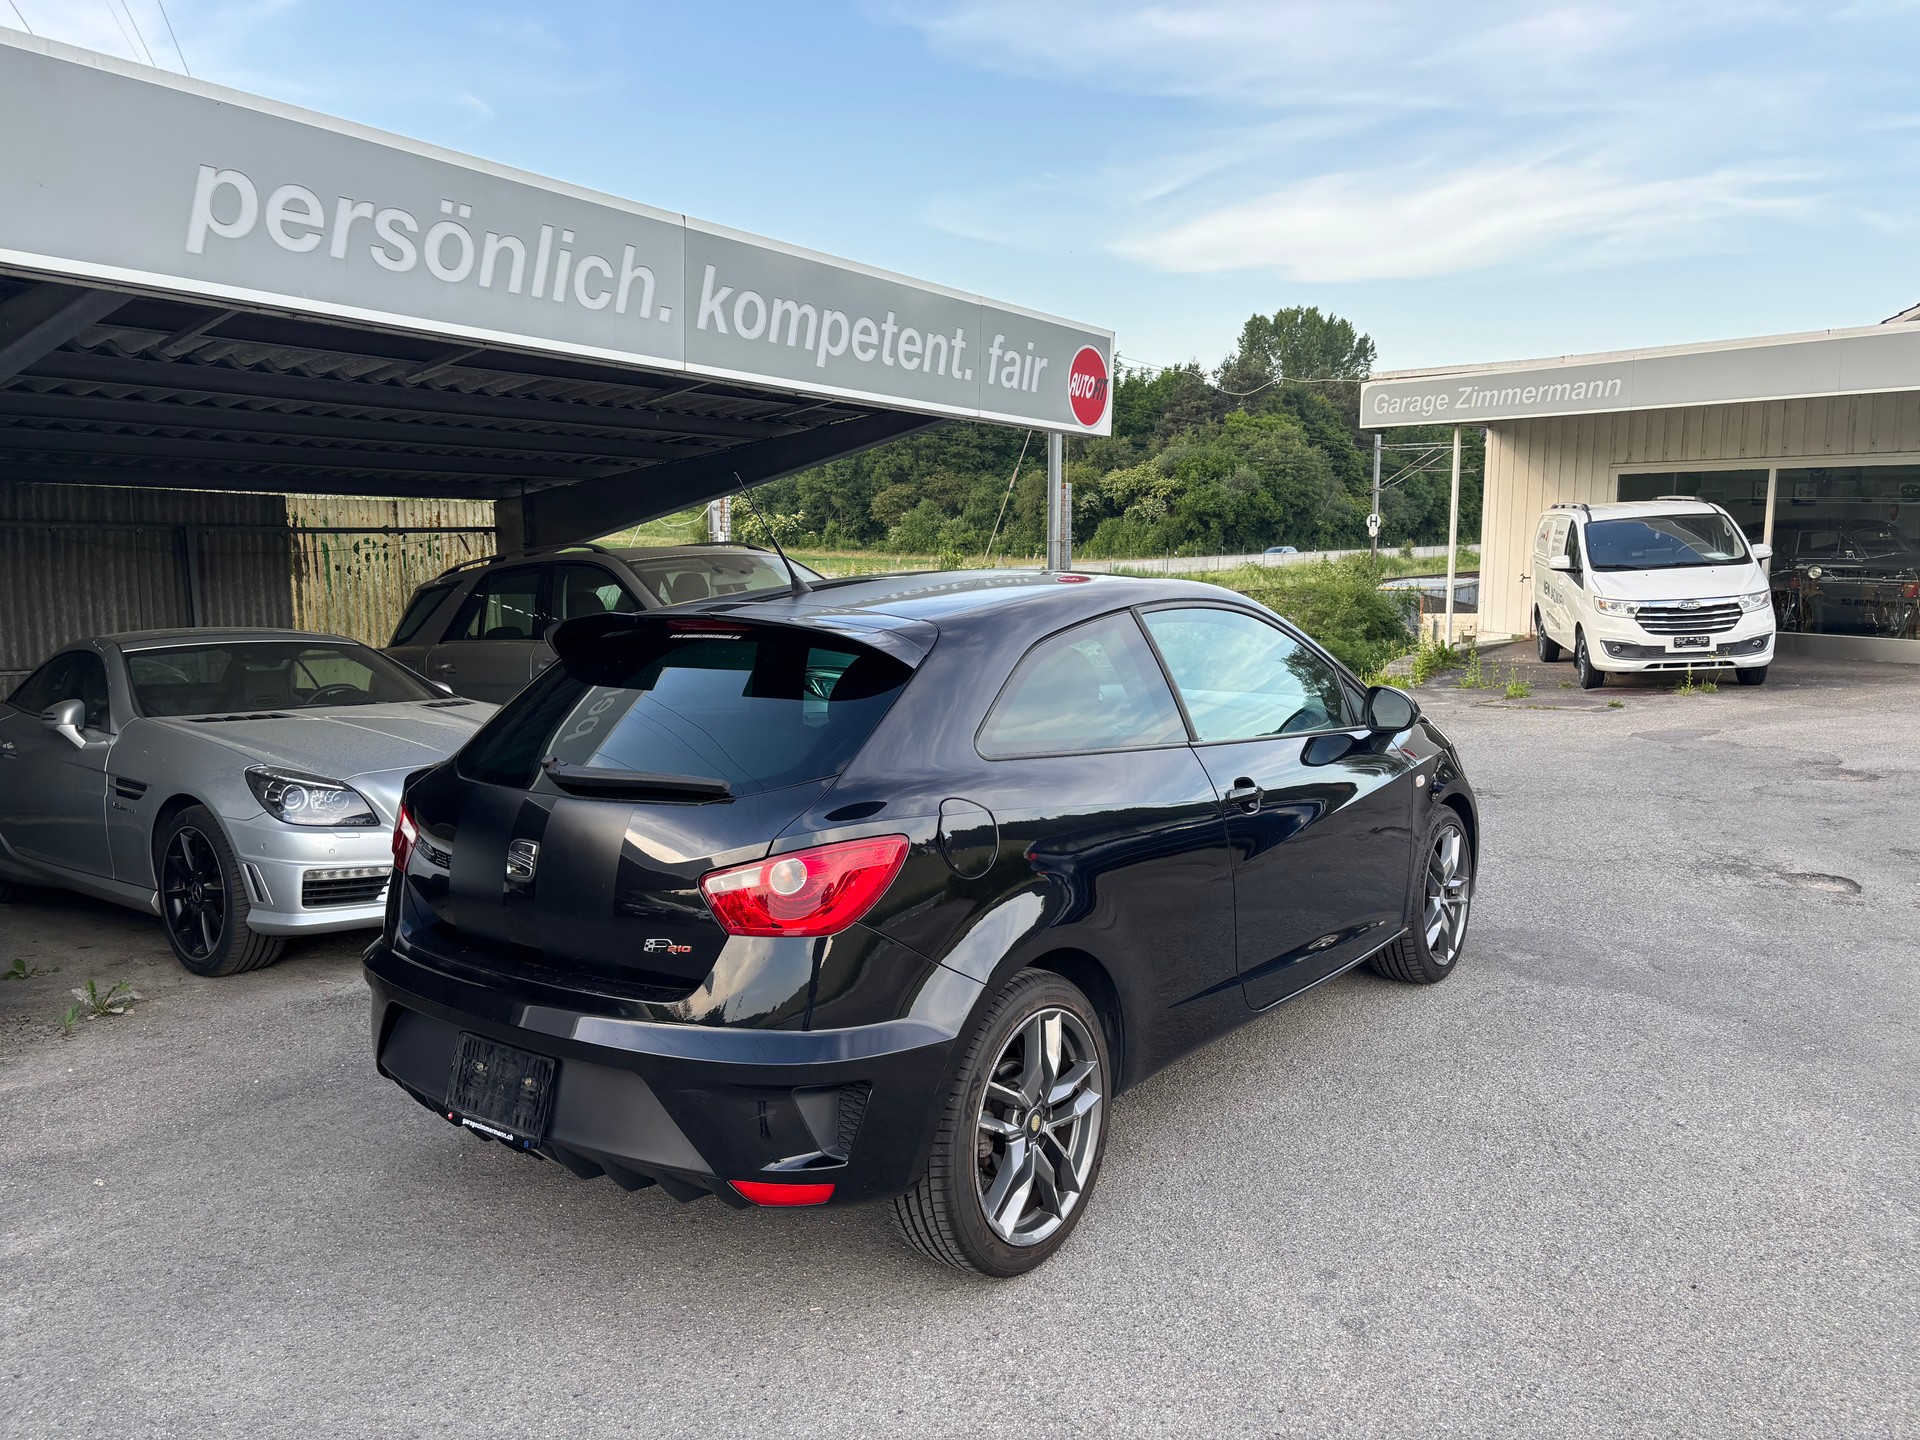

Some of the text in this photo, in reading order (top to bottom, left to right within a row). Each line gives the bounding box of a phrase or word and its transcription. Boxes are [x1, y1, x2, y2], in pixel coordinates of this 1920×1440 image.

[185, 163, 1049, 393] persönlich. kompetent. fair
[1373, 377, 1622, 417] Garage Zimmermann
[1370, 516, 1377, 527] H
